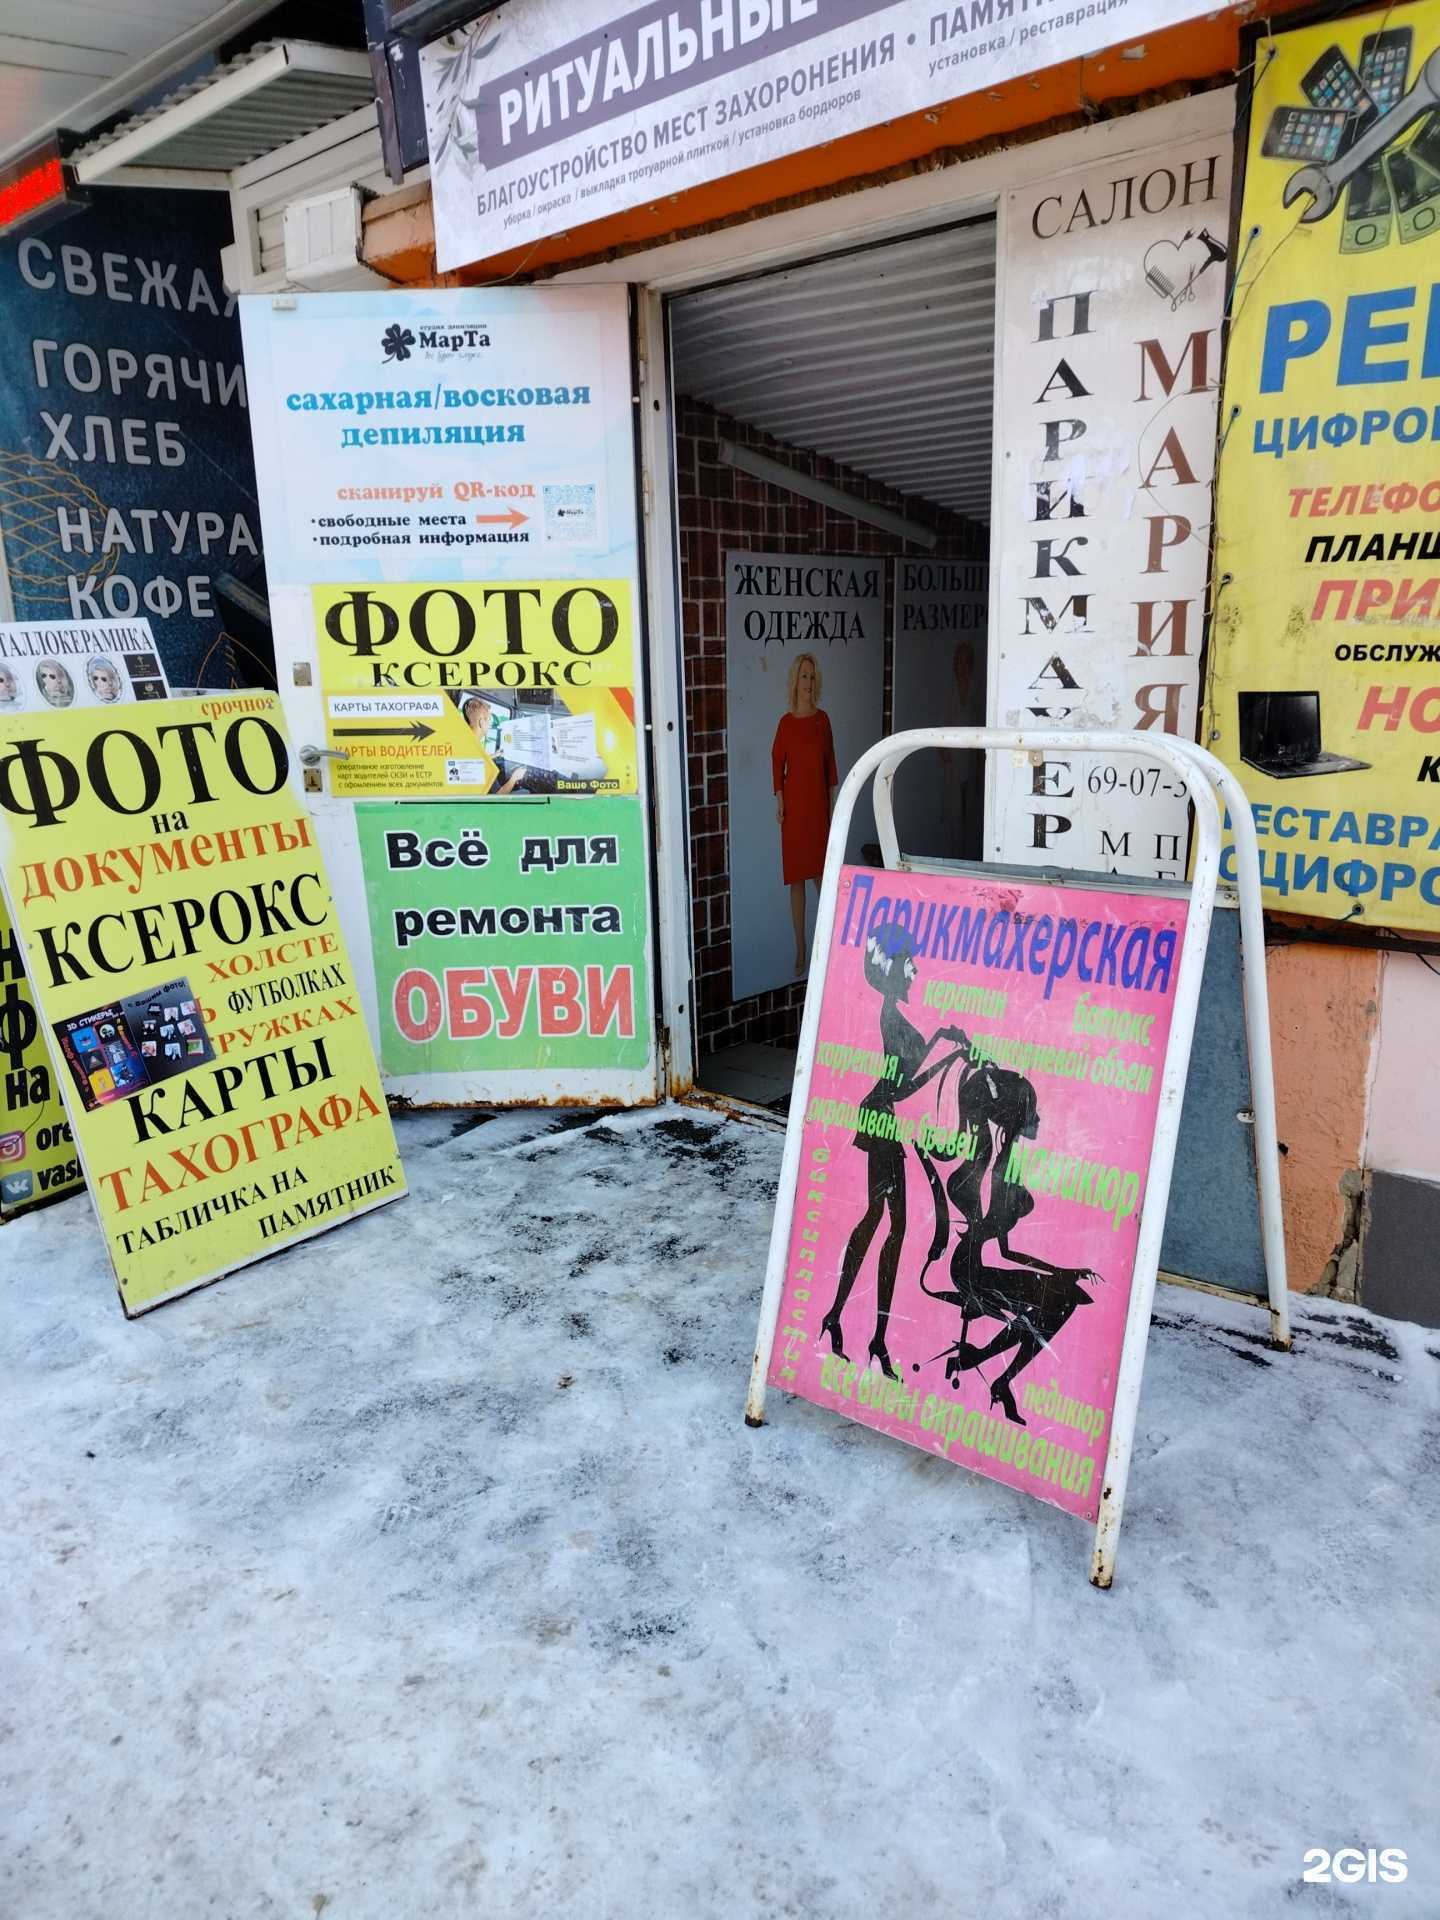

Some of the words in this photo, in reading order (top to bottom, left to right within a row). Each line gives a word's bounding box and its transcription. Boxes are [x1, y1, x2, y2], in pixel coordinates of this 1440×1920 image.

[929, 35, 1007, 76] установка
[476, 130, 648, 216] БЛАГОУСТРОЙСТВО
[653, 105, 709, 149] МЕСТ
[715, 32, 896, 126] ЗАХОРОНЕНИЯ
[503, 208, 532, 230] уборка
[537, 195, 572, 214] окраска
[580, 175, 626, 199] выкладка
[628, 151, 685, 184] тротуарной
[686, 134, 731, 162] плиткой
[738, 112, 796, 146] установка
[799, 89, 862, 121] бордюров
[1032, 155, 1221, 240] САЛОН
[418, 331, 491, 351] МарТа
[32, 339, 248, 408] ГОРЯЧИ
[286, 383, 591, 415] сахарная/восковая
[40, 411, 186, 467] ХЛЕБ
[341, 423, 525, 448] депиляция
[337, 481, 443, 503] сканируй
[453, 482, 536, 499] QR-код
[57, 506, 258, 555] НАТУРА
[318, 513, 411, 528] свободные
[418, 513, 467, 526] места
[319, 531, 411, 547] подробная
[418, 530, 530, 547] информация
[67, 574, 214, 620] КОФЕ
[734, 565, 881, 598] ЖЕНСКАЯ
[325, 587, 619, 657] ФОТО
[744, 611, 865, 647] ОДЕЖДА
[369, 660, 592, 688] КСЕРОКС
[334, 702, 373, 713] КАРТЫ
[375, 700, 440, 713] ТАХОГРАФА
[0, 716, 289, 829] ФОТО
[381, 742, 453, 758] ВОДИТЕЛЕЙ
[557, 780, 587, 790] Ваше
[590, 780, 619, 790] Фото
[150, 811, 189, 834] на
[20, 817, 313, 908] документы
[386, 830, 489, 869] Всё
[520, 837, 618, 872] для
[34, 873, 329, 988] КСЕРОКС
[395, 905, 621, 946] ремонта
[841, 874, 1178, 999] Парикмахерская
[205, 933, 339, 983] ХОЛСТЕ
[227, 963, 346, 1015] ФУТБОЛКАХ
[394, 966, 635, 1041] ОБУВИ
[923, 979, 1009, 1019] кератин
[209, 997, 358, 1055] РУЖКАХ
[5, 1065, 50, 1111] на
[126, 1036, 336, 1144] КАРТЫ
[99, 1085, 382, 1213] ТАХОГРАФА
[809, 1098, 915, 1144] окрашивание
[917, 1113, 979, 1161] бровей
[116, 1182, 267, 1256] ТАБЛИЧКА
[273, 1166, 309, 1195] НА
[258, 1164, 397, 1240] ПАМЯТНИК
[820, 1353, 857, 1398] все
[858, 1362, 921, 1424] виды
[920, 1393, 1096, 1498] окрашивания
[1023, 1378, 1105, 1446] педикюр
